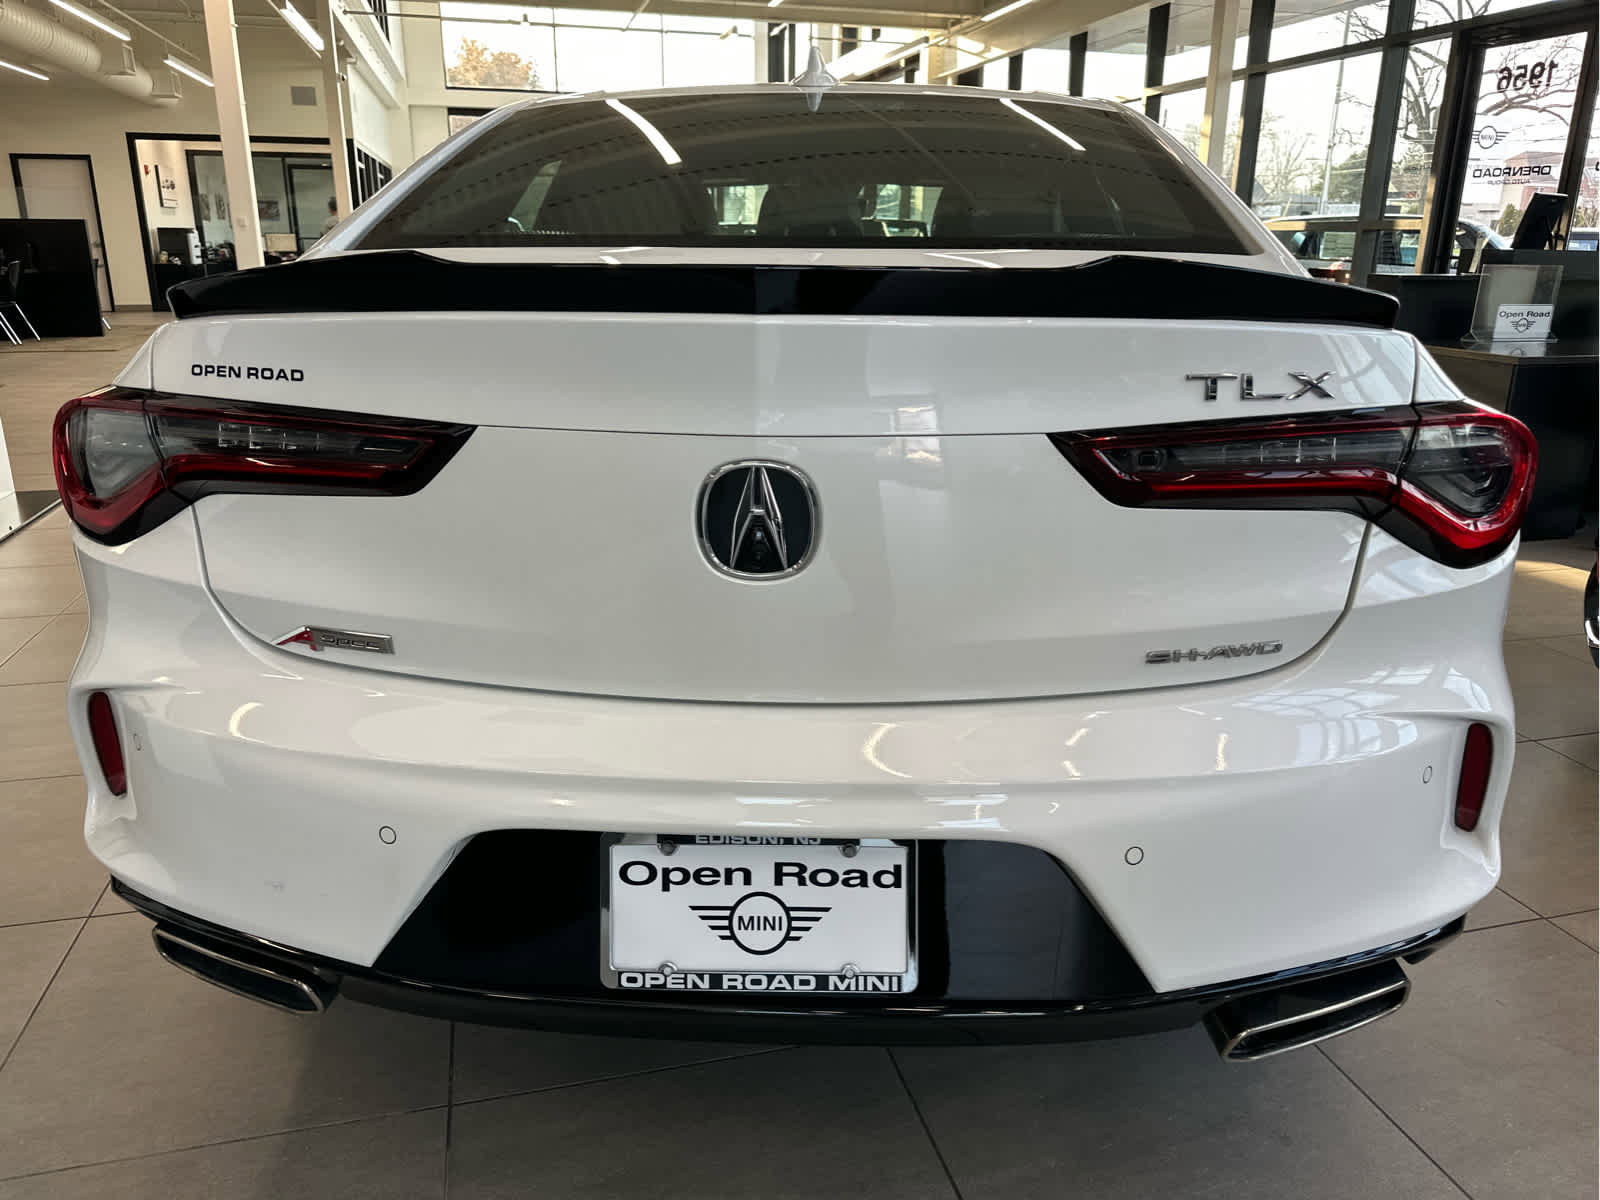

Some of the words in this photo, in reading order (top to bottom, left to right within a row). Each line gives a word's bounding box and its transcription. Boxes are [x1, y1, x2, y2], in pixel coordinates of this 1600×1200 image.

[1499, 311, 1524, 319] Open
[191, 364, 241, 378] OPEN
[247, 366, 304, 382] ROAD
[1185, 371, 1336, 401] TLX
[1145, 640, 1283, 664] SH-AWD
[793, 836, 821, 845] NJ
[618, 860, 753, 892] Open
[773, 861, 903, 889] Road
[737, 915, 783, 931] MINI
[620, 971, 710, 989] OPEN
[722, 973, 817, 991] ROAD
[828, 974, 899, 992] MINI
